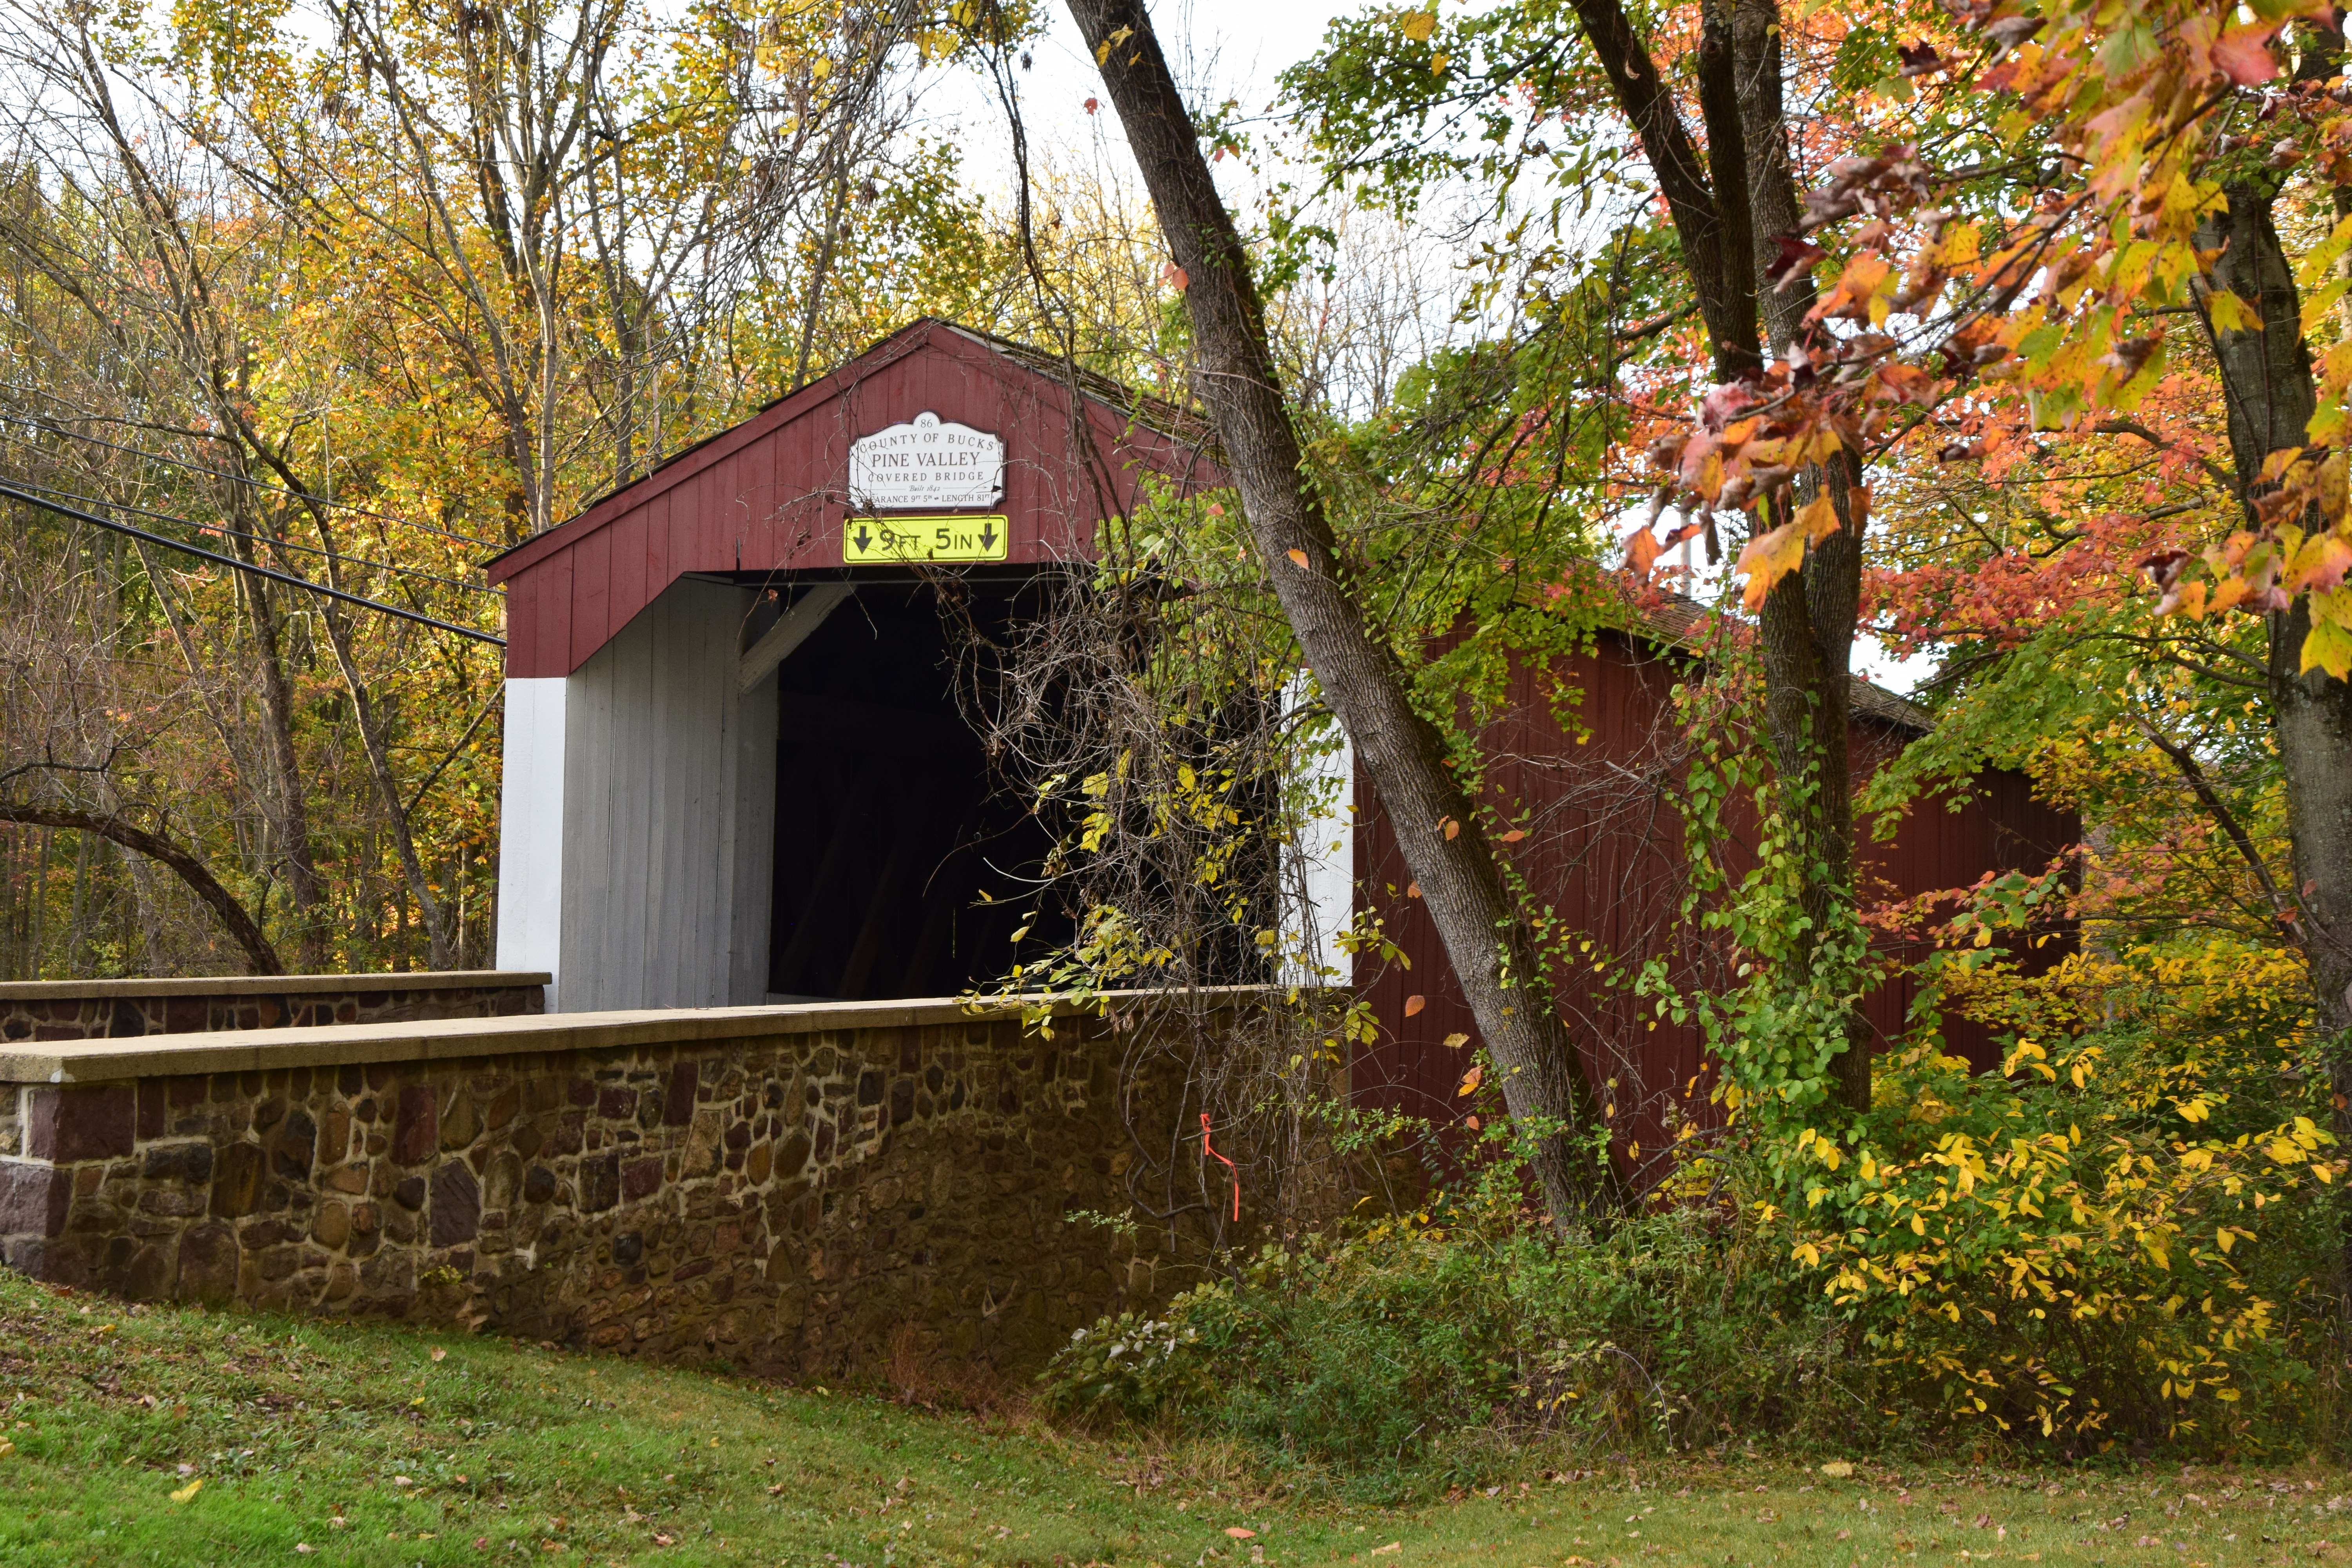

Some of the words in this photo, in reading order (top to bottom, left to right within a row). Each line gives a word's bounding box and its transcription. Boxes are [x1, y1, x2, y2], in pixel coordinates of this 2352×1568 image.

[920, 419, 933, 428] 86
[860, 434, 917, 453] COUNTY
[924, 433, 939, 442] OF
[948, 434, 994, 450] BUCKS
[872, 453, 909, 467] PINE
[916, 452, 980, 466] VALLEY
[868, 473, 927, 482] COVERED
[936, 472, 983, 481] BRIDGE
